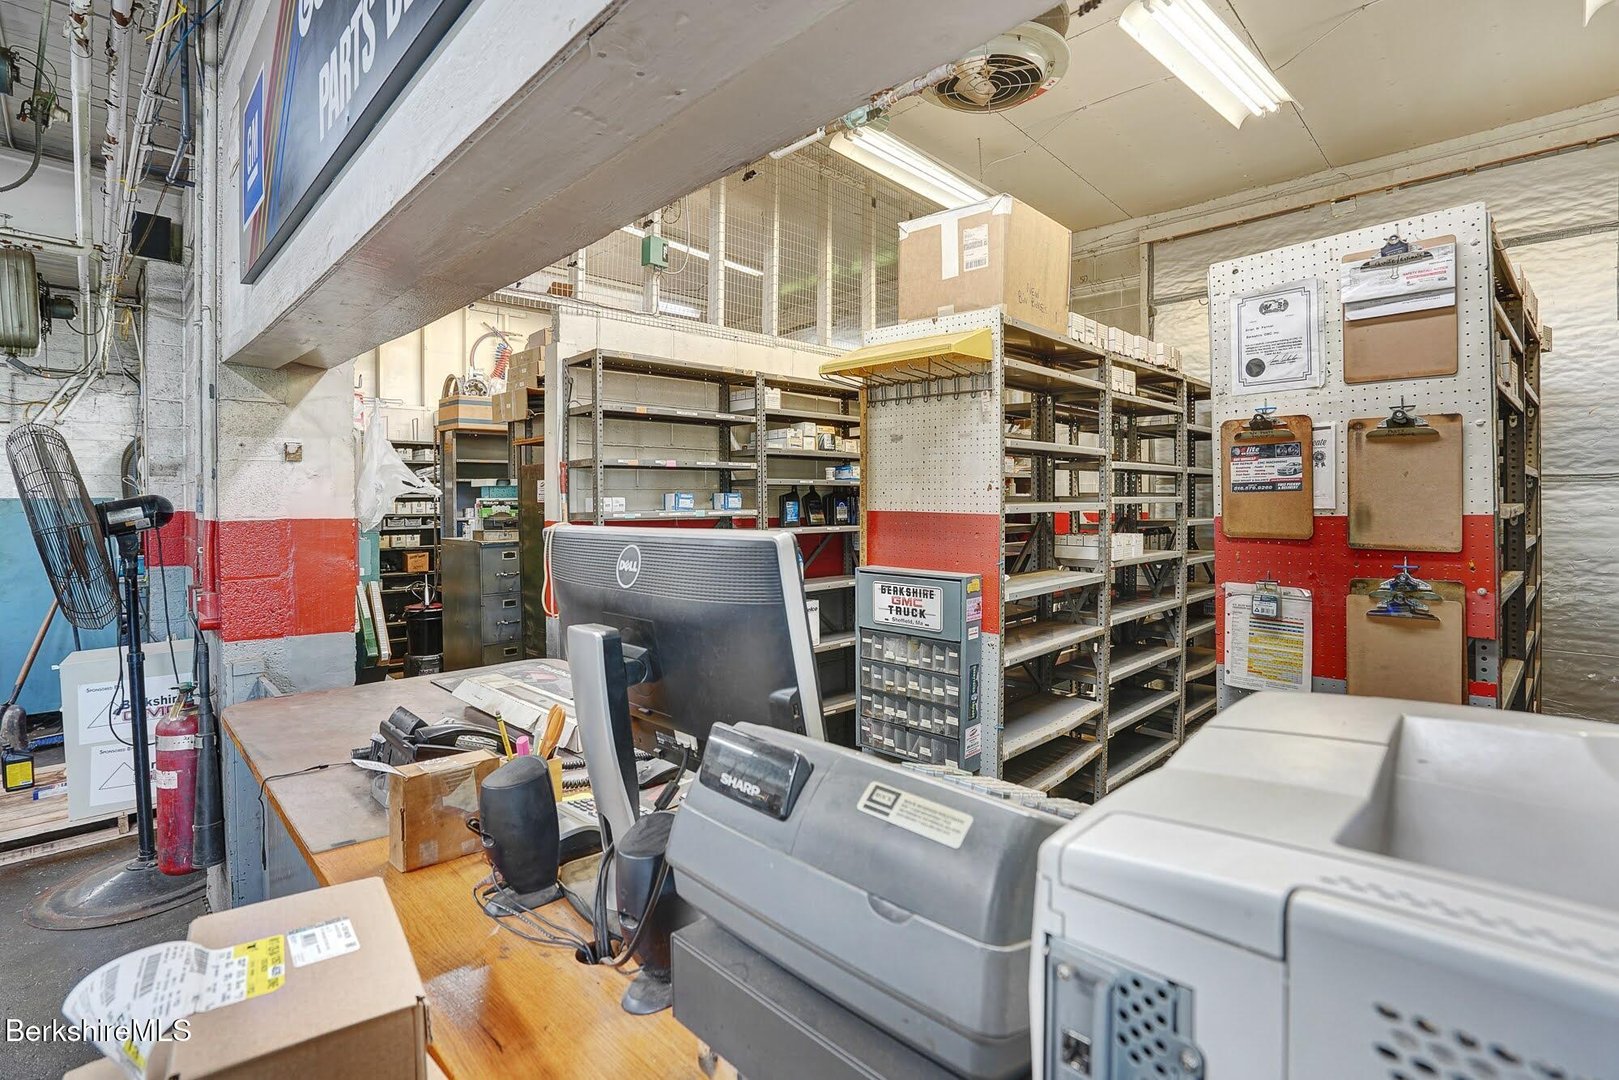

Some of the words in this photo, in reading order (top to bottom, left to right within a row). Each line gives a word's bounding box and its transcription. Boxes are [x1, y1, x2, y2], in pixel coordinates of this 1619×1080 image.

[318, 0, 376, 143] PARTS
[247, 110, 259, 175] GM
[619, 559, 638, 572] DELL
[880, 585, 935, 599] BERKSHIRE
[891, 596, 923, 608] GMC
[888, 605, 926, 619] TRUCK
[720, 772, 761, 797] SHARP
